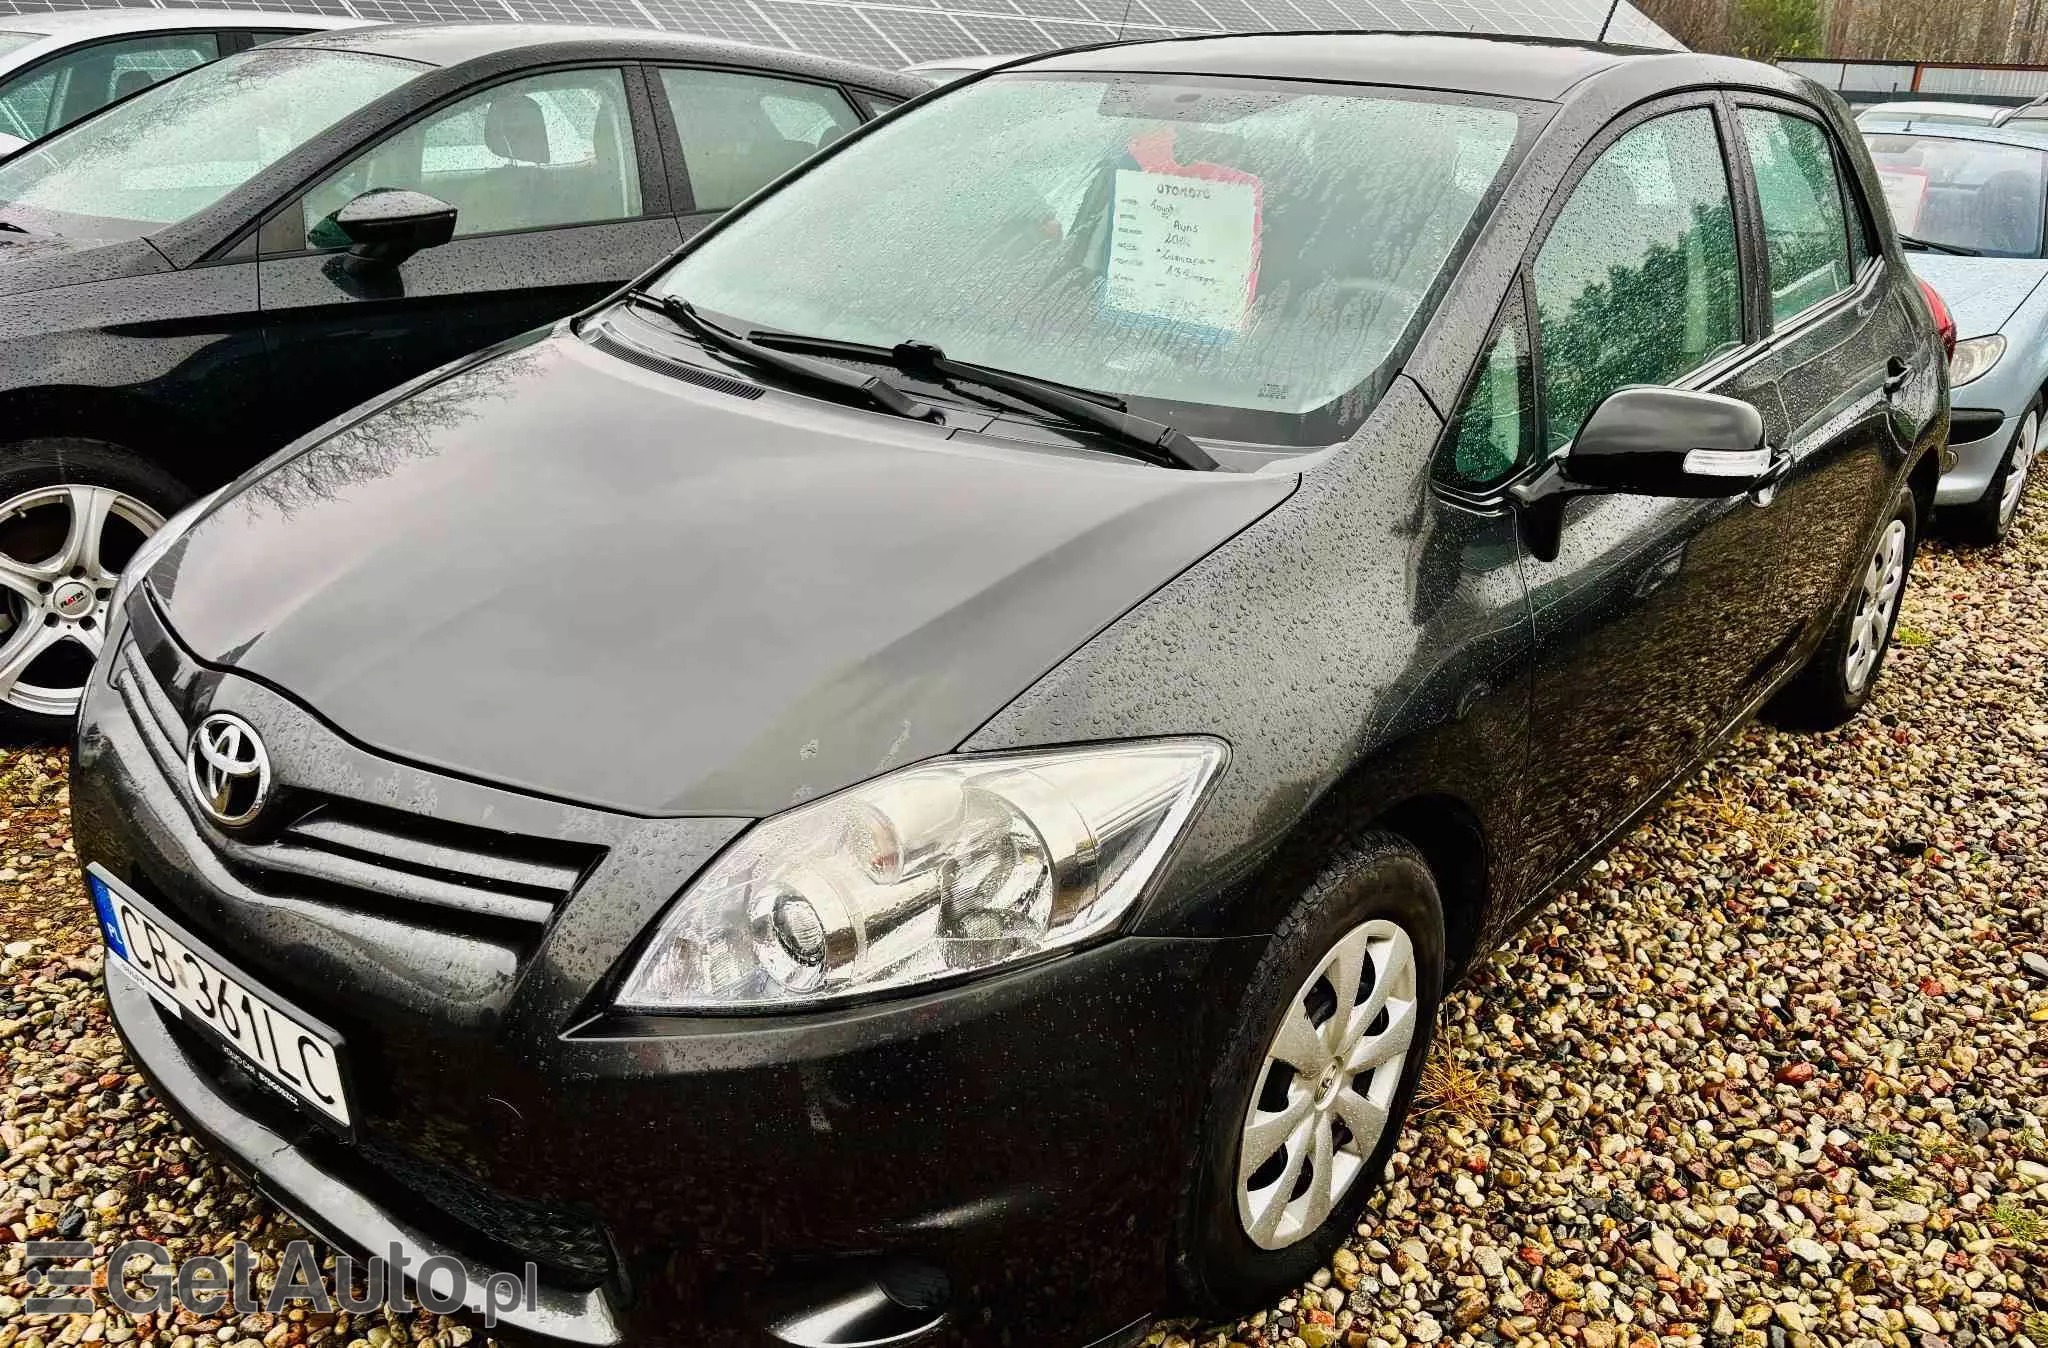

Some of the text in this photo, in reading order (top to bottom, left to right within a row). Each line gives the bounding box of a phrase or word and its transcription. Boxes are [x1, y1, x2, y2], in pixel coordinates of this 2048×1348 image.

[106, 921, 123, 945] PL
[121, 905, 335, 1106] CB 361LC
